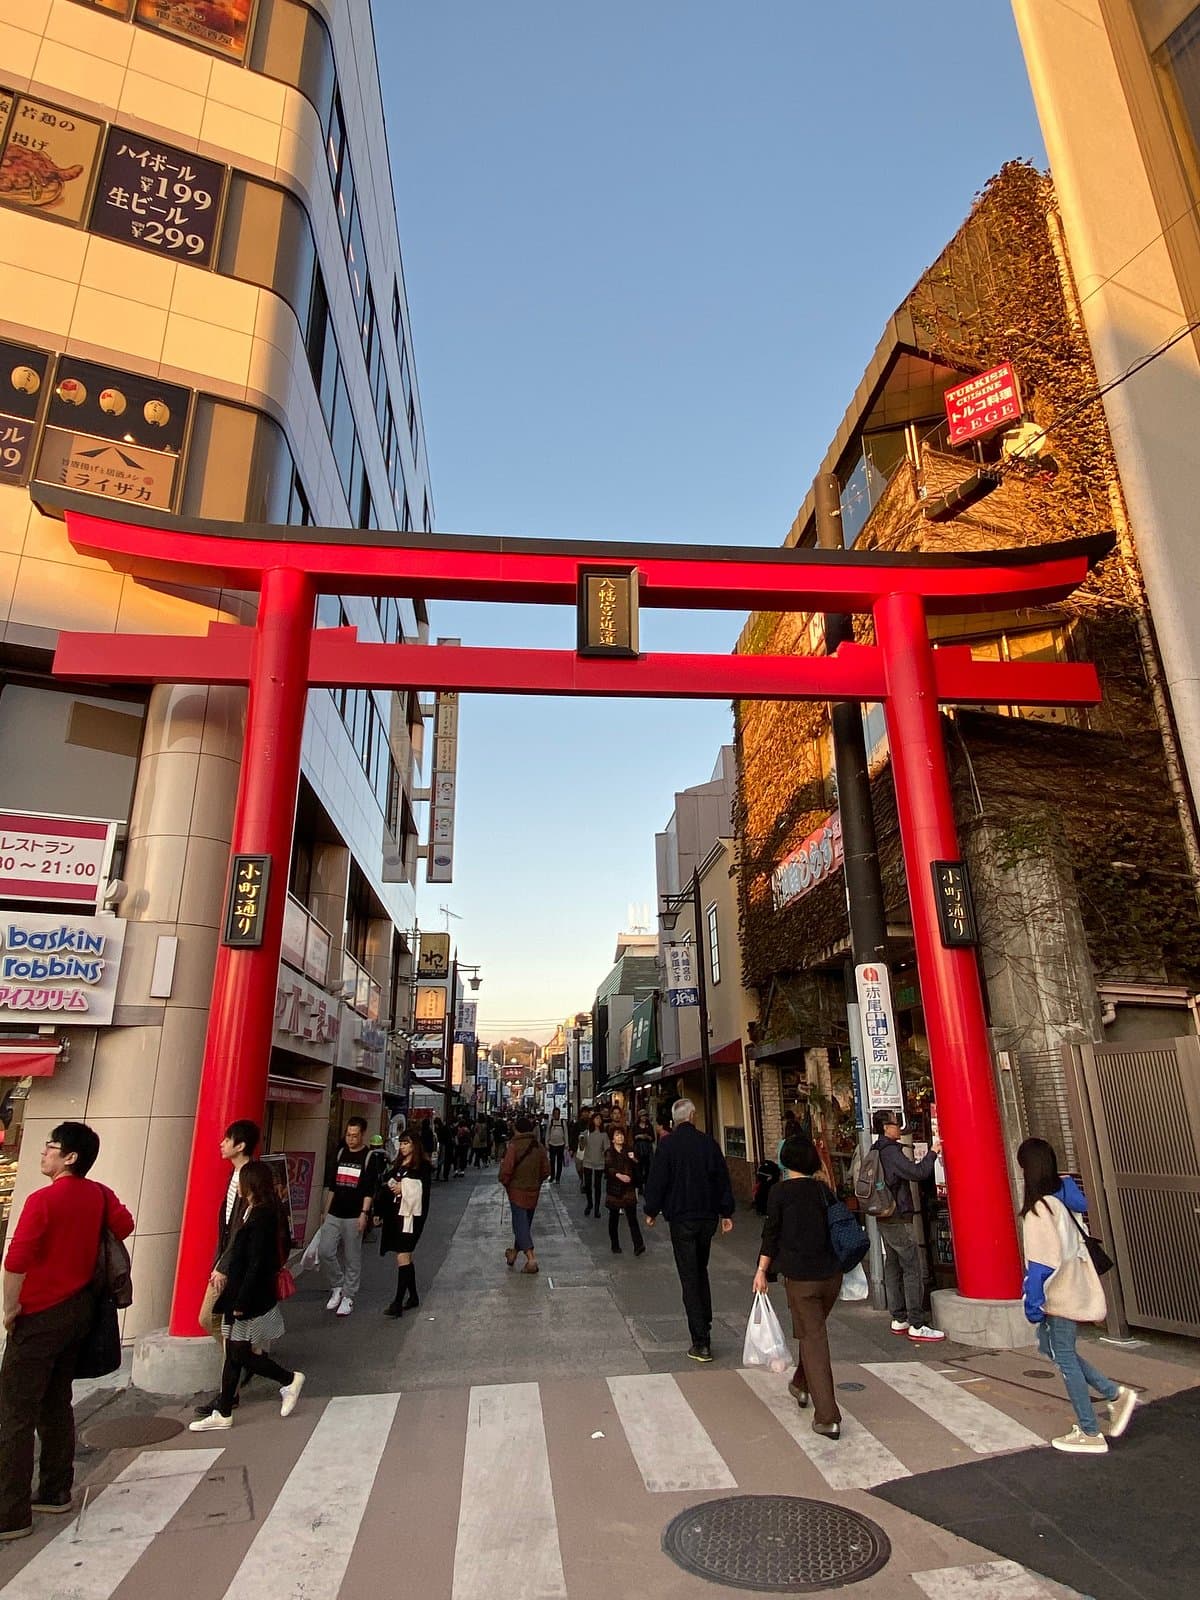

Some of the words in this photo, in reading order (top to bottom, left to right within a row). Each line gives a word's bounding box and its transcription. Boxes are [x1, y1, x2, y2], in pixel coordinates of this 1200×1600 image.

[117, 144, 196, 181] ハイボール
[106, 186, 189, 225] 生ビール
[140, 176, 212, 211] ¥199
[131, 220, 205, 255] ¥299
[952, 386, 1013, 423] トルコ料理
[59, 468, 152, 501] ミライザカ
[1, 837, 75, 855] レストラン
[234, 863, 261, 936] 小町通り
[942, 870, 967, 937] 小町通り
[0, 988, 87, 1009] アイスクリーム
[872, 1036, 888, 1062] 医院
